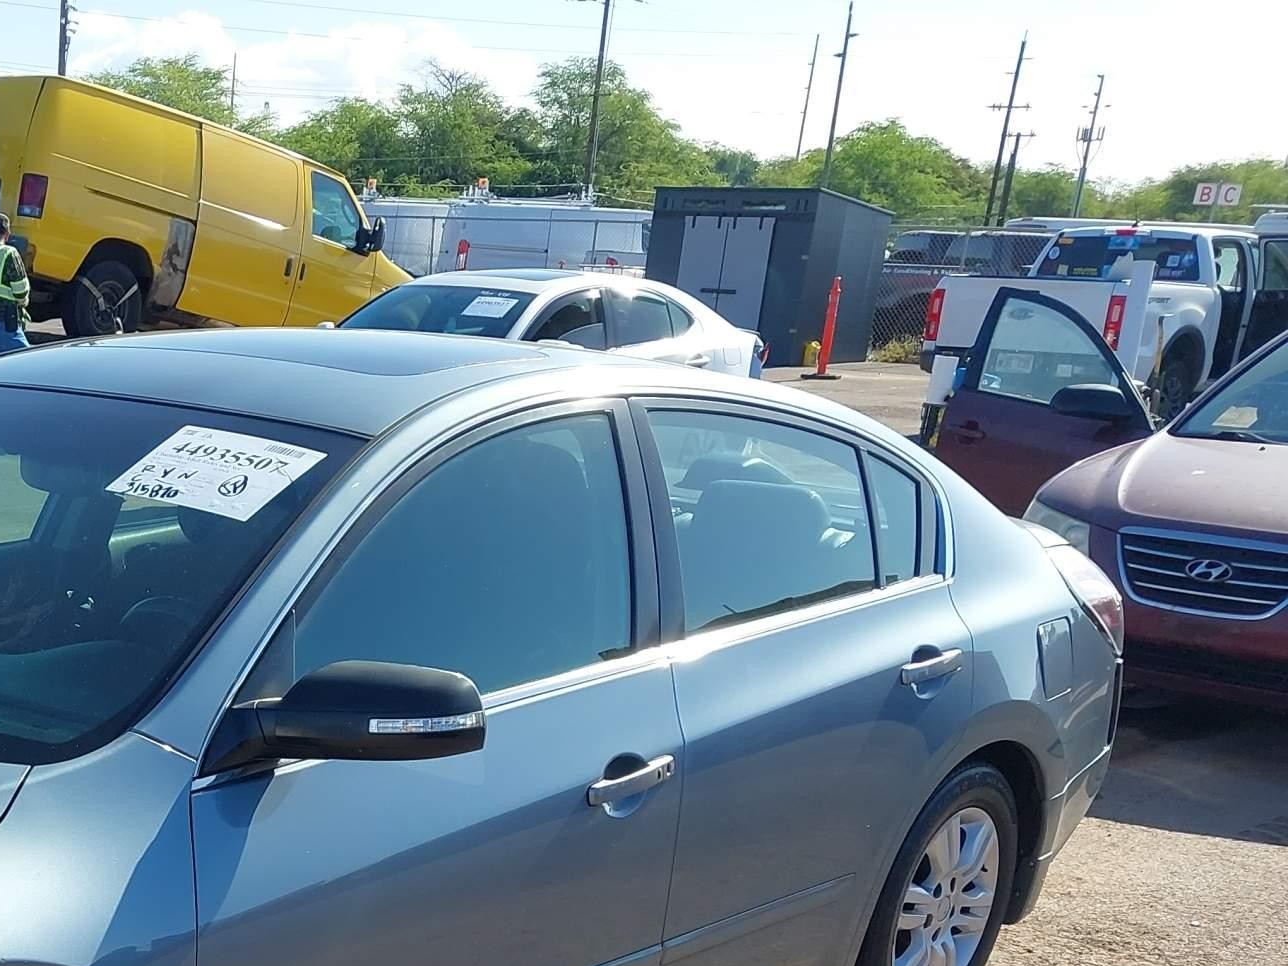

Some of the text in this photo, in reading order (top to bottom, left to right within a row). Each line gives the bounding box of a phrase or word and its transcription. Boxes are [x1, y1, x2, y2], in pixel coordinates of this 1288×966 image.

[1199, 186, 1213, 202] B
[1224, 187, 1237, 203] C
[172, 442, 290, 473] 44935507
